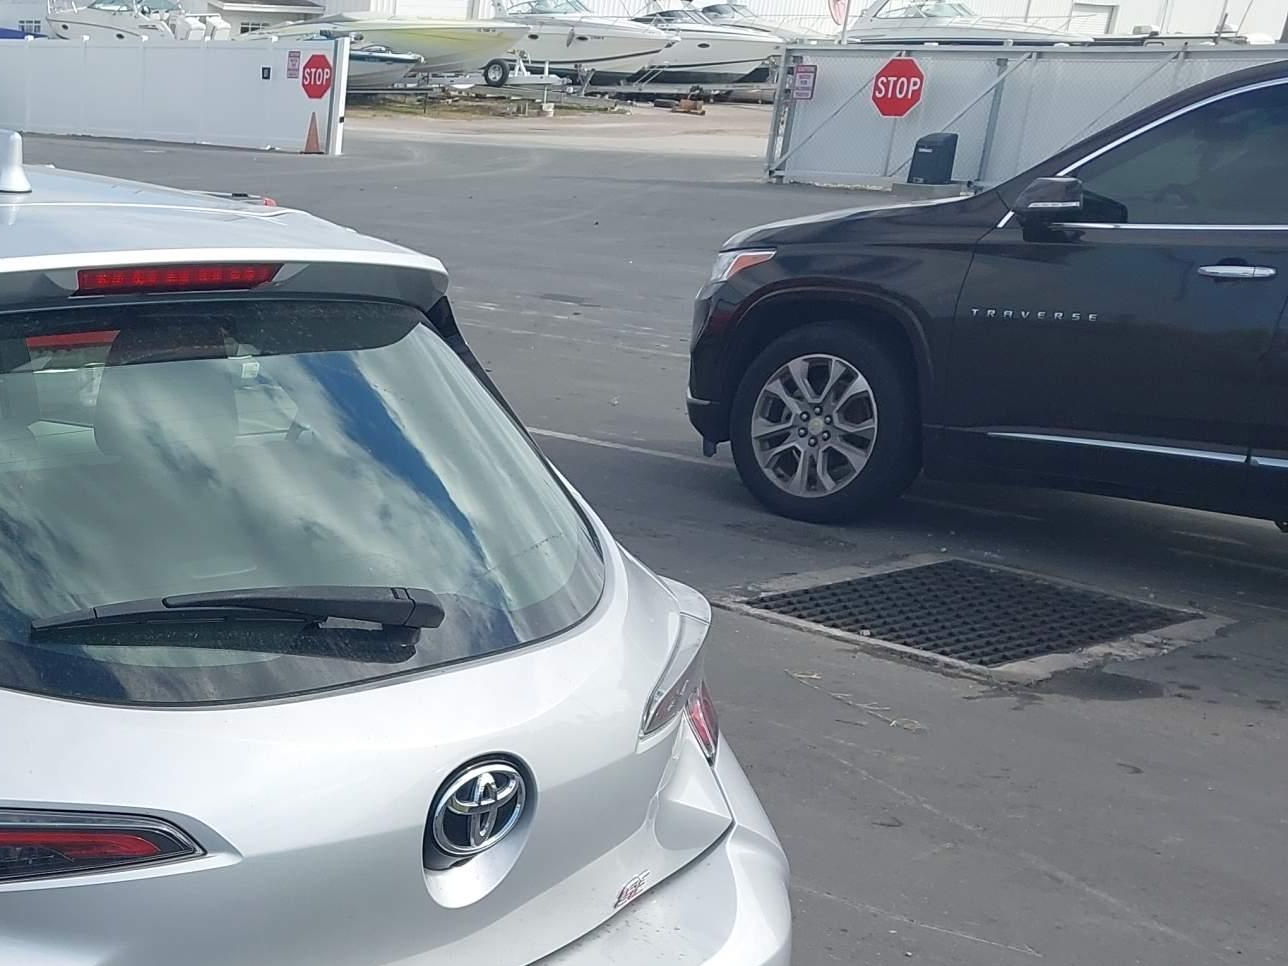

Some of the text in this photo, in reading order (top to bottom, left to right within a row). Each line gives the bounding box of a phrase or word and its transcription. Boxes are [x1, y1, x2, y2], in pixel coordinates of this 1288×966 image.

[303, 68, 330, 85] STOP
[875, 77, 921, 99] STOP
[971, 308, 1098, 321] TRAVERSE
